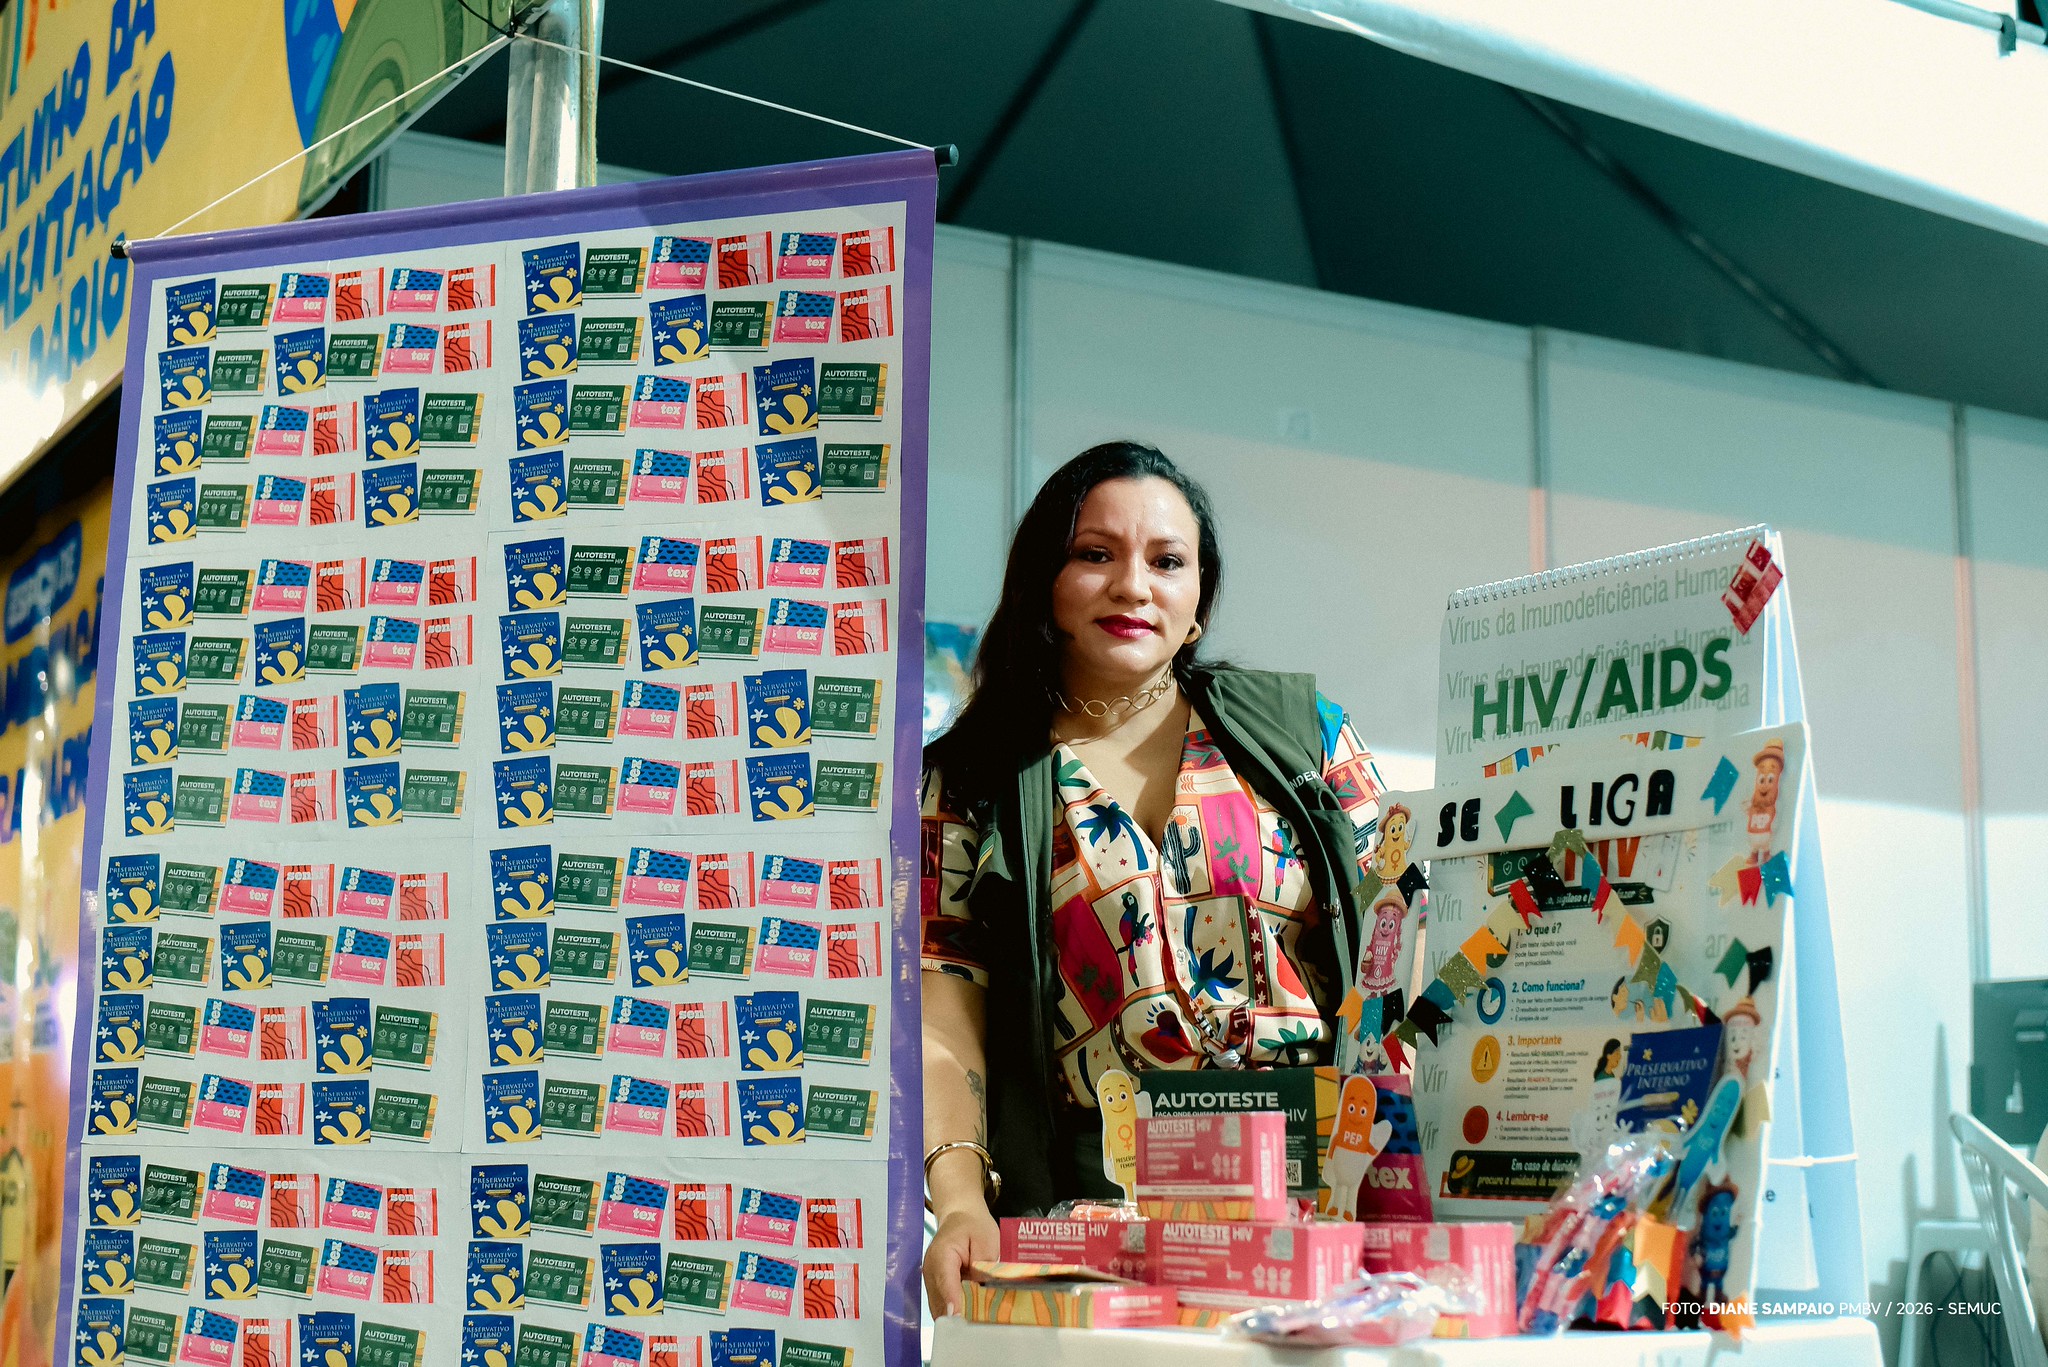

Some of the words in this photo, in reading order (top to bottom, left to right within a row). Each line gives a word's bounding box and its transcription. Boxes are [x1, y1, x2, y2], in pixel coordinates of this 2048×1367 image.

[524, 253, 575, 267] PRESERVATIVO
[590, 253, 629, 261] AUTOTESTE
[806, 258, 827, 267] tex
[536, 260, 566, 269] INTERNO
[716, 307, 755, 315] AUTOTESTE
[805, 320, 824, 330] tex
[509, 549, 560, 560] PRESERVATIVO
[799, 566, 821, 576] tex
[202, 574, 238, 582] AUTOTESTE
[283, 588, 302, 598] tex
[704, 612, 744, 620] AUTOTESTE
[1448, 614, 1490, 645] Vírus
[1496, 608, 1516, 635] da
[1522, 576, 1668, 632] Imunodeficiência
[570, 623, 611, 631] AUTOTESTE
[749, 681, 802, 693] PRESERVATIVO
[759, 687, 793, 695] INTERNO
[818, 684, 862, 693] AUTOTESTE
[1472, 638, 1732, 739] HIV/AIDS
[563, 694, 601, 703] AUTOTESTE
[261, 726, 278, 735] tex
[1437, 798, 1481, 847] SE
[1560, 769, 1675, 829] LIGA
[496, 858, 546, 868] PRESERVATIVO
[562, 861, 604, 870] AUTOTESTE
[110, 866, 155, 874] PRESERVATIVO
[168, 869, 206, 878] AUTOTESTE
[657, 882, 679, 893] tex
[791, 885, 812, 896] tex
[695, 930, 736, 938] AUTOTESTE
[1534, 924, 1549, 937] que
[279, 937, 316, 946] AUTOTESTE
[789, 951, 810, 962] tex
[1512, 982, 1519, 993] 2.
[1522, 981, 1544, 992] Como
[1546, 979, 1585, 991] funciona?
[810, 1007, 855, 1017] AUTOTESTE
[227, 1033, 245, 1044] tex
[640, 1030, 659, 1041] tex
[1508, 1036, 1515, 1046] 3.
[1518, 1035, 1562, 1047] Importante
[1627, 1058, 1708, 1076] PRESERVATIVO
[1637, 1074, 1690, 1089] INTERNO
[548, 1086, 587, 1095] AUTOTESTE
[1155, 1092, 1279, 1108] AUTOTESTE
[1506, 1110, 1549, 1121] Lembre-se
[1147, 1120, 1195, 1134] AUTOTESTE
[1343, 1131, 1362, 1146] PEP
[1511, 1158, 1523, 1171] Em
[1524, 1161, 1540, 1171] caso
[1542, 1160, 1550, 1171] de
[149, 1172, 187, 1182] AUTOTESTE
[473, 1176, 523, 1184] PRESERVATIVO
[1367, 1166, 1413, 1190] tex
[234, 1197, 254, 1209] tex
[352, 1209, 372, 1220] tex
[633, 1207, 656, 1220] tex
[1018, 1221, 1085, 1236] AUTOTESTE
[1088, 1224, 1109, 1237] HIV
[1162, 1222, 1230, 1239] AUTOTESTE
[1232, 1225, 1253, 1241] HIV
[533, 1257, 575, 1268] AUTOTESTE
[606, 1254, 655, 1263] PRESERVATIVO
[672, 1260, 713, 1271] AUTOTESTE
[765, 1287, 787, 1300] tex
[132, 1314, 166, 1324] AUTOTESTE
